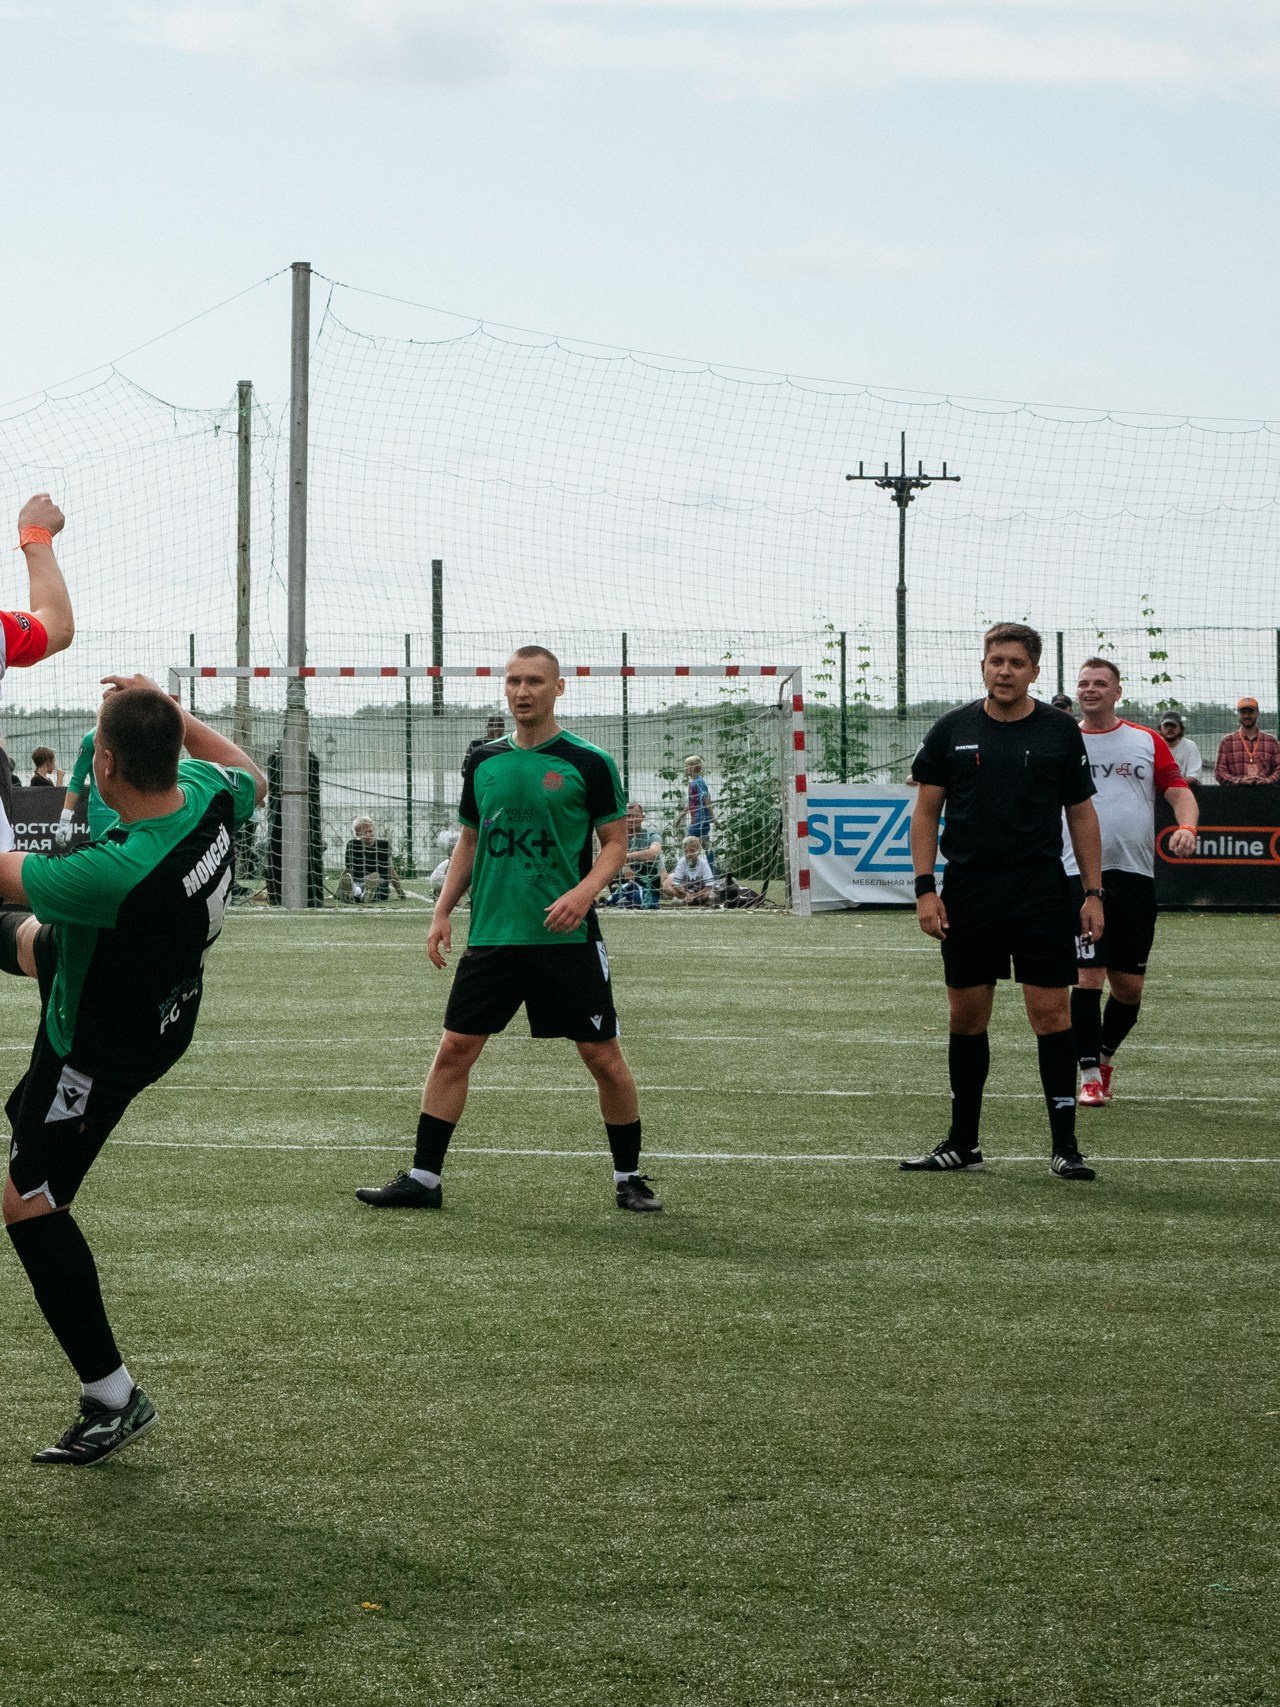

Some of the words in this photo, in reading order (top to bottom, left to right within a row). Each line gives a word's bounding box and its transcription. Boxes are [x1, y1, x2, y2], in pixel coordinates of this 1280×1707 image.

[182, 822, 231, 898] МОИСЕЙ
[807, 799, 946, 873] SEZA
[1195, 835, 1264, 857] inline
[852, 878, 905, 888] МЕБЕЛЬНАЯ
